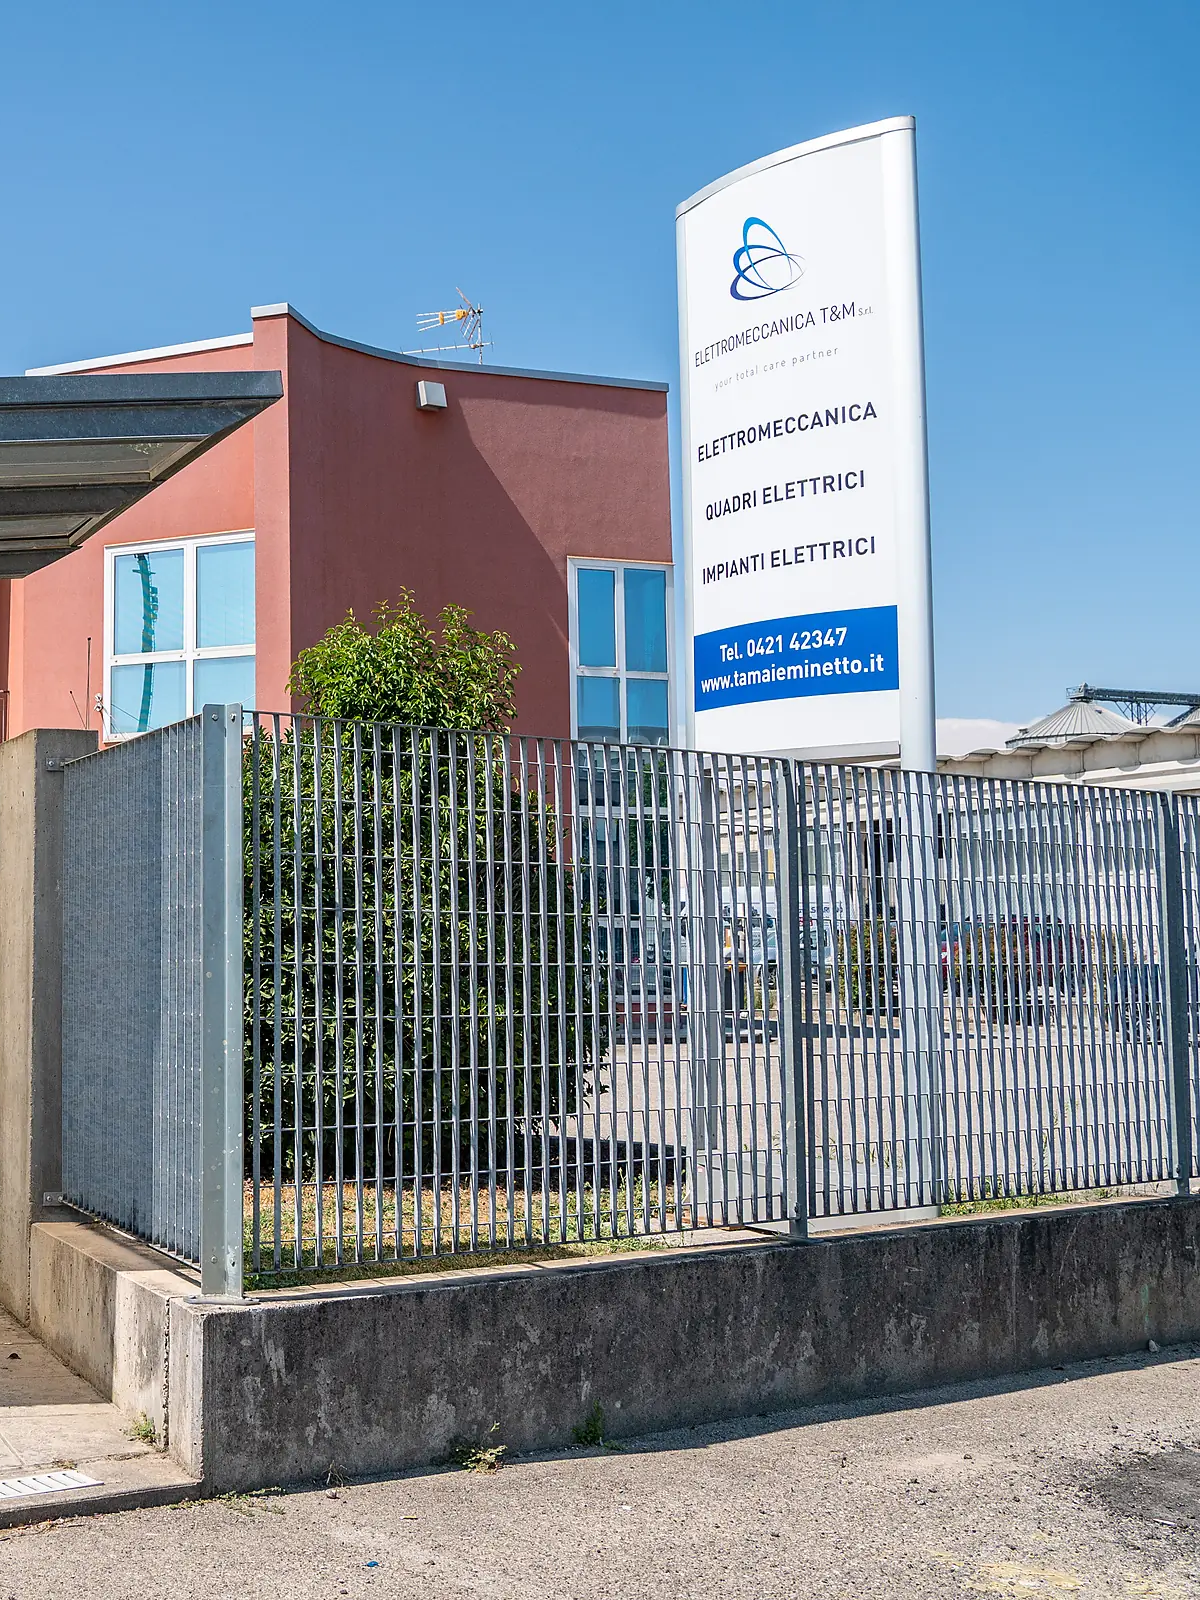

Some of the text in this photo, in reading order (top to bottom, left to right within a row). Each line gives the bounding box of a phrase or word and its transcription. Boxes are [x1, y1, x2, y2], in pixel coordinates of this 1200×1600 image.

[695, 302, 874, 368] ELETTROMECCANICA T&M S.r.l.
[714, 347, 839, 392] your total care partner
[698, 401, 878, 463] ELETTROMECCANICA
[705, 470, 865, 521] QUADRI ELETTRICI
[702, 536, 876, 585] IMPIANTI ELETTRICI
[720, 626, 848, 663] Tel. 0421 42347
[700, 653, 885, 694] www.tamaieminetto.it
